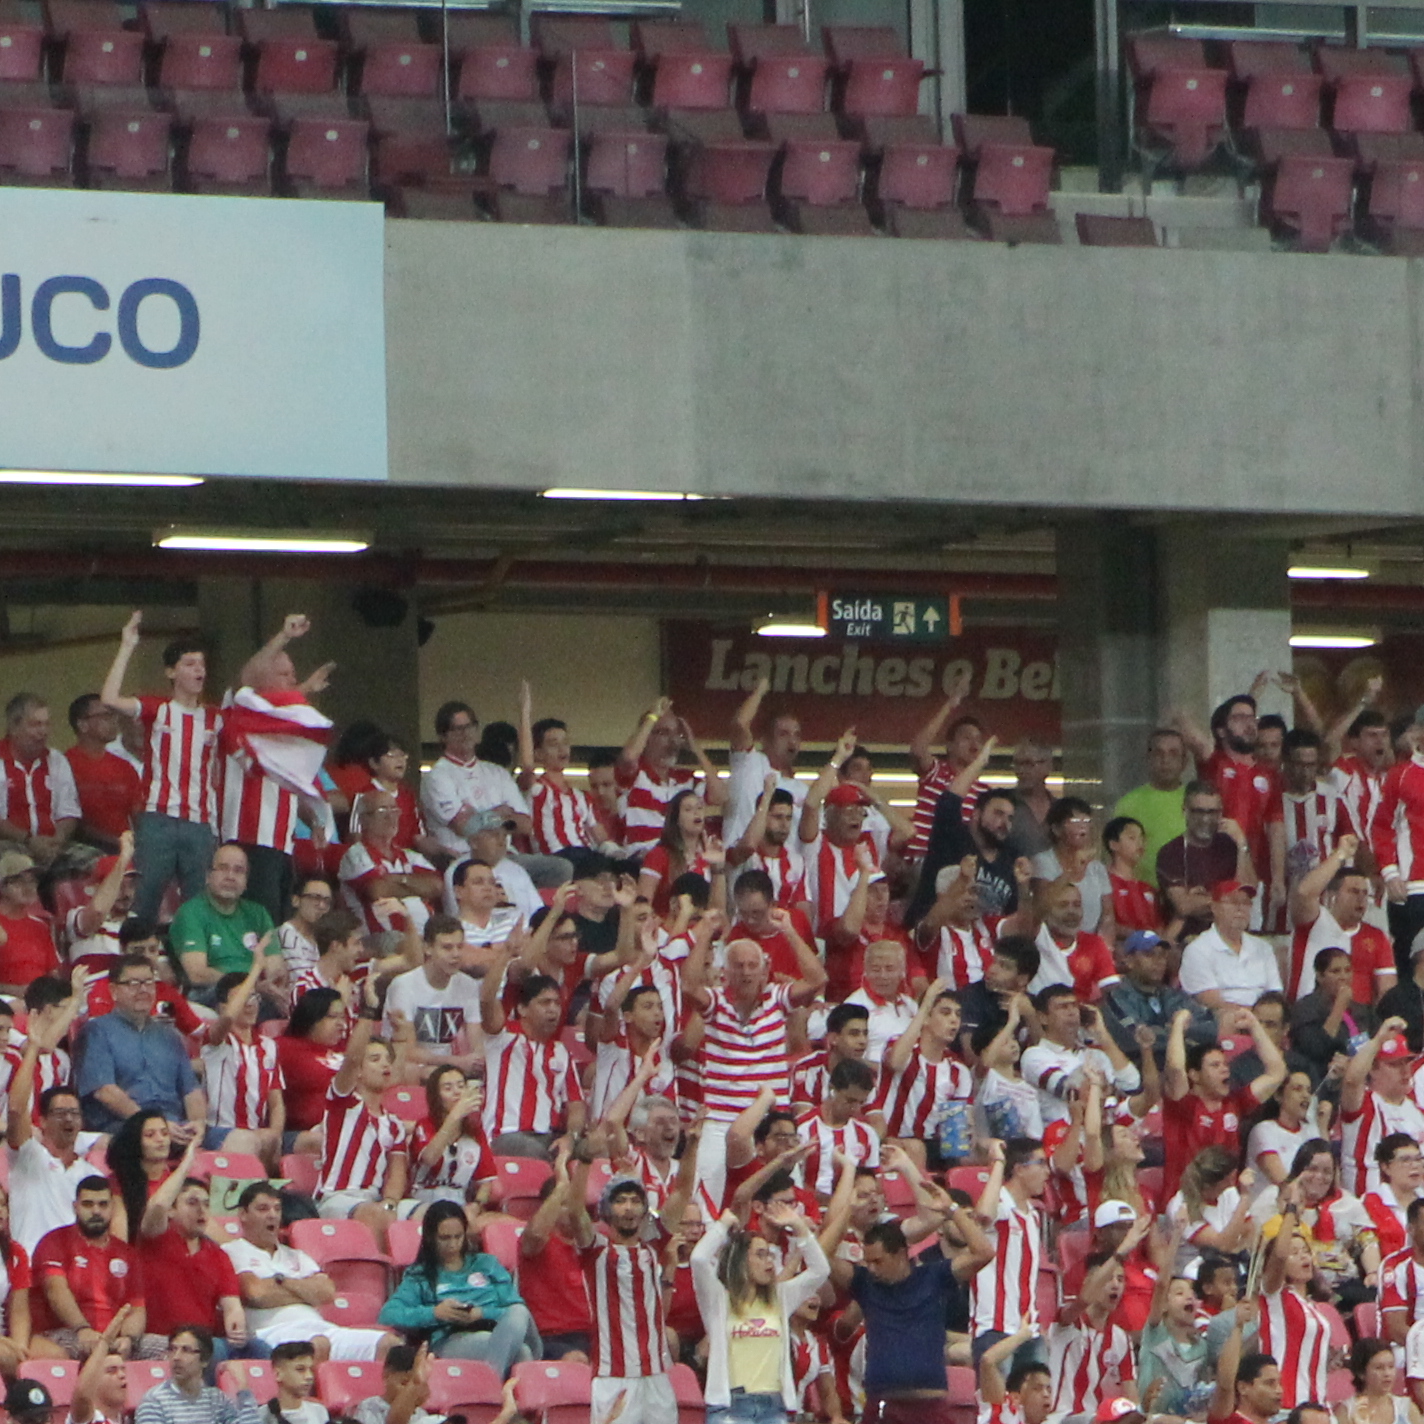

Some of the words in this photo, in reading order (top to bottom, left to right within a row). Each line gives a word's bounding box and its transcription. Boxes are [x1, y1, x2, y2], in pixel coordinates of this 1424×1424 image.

[832, 599, 883, 622] Saída
[846, 622, 871, 637] Exit
[704, 639, 935, 697] Lanches
